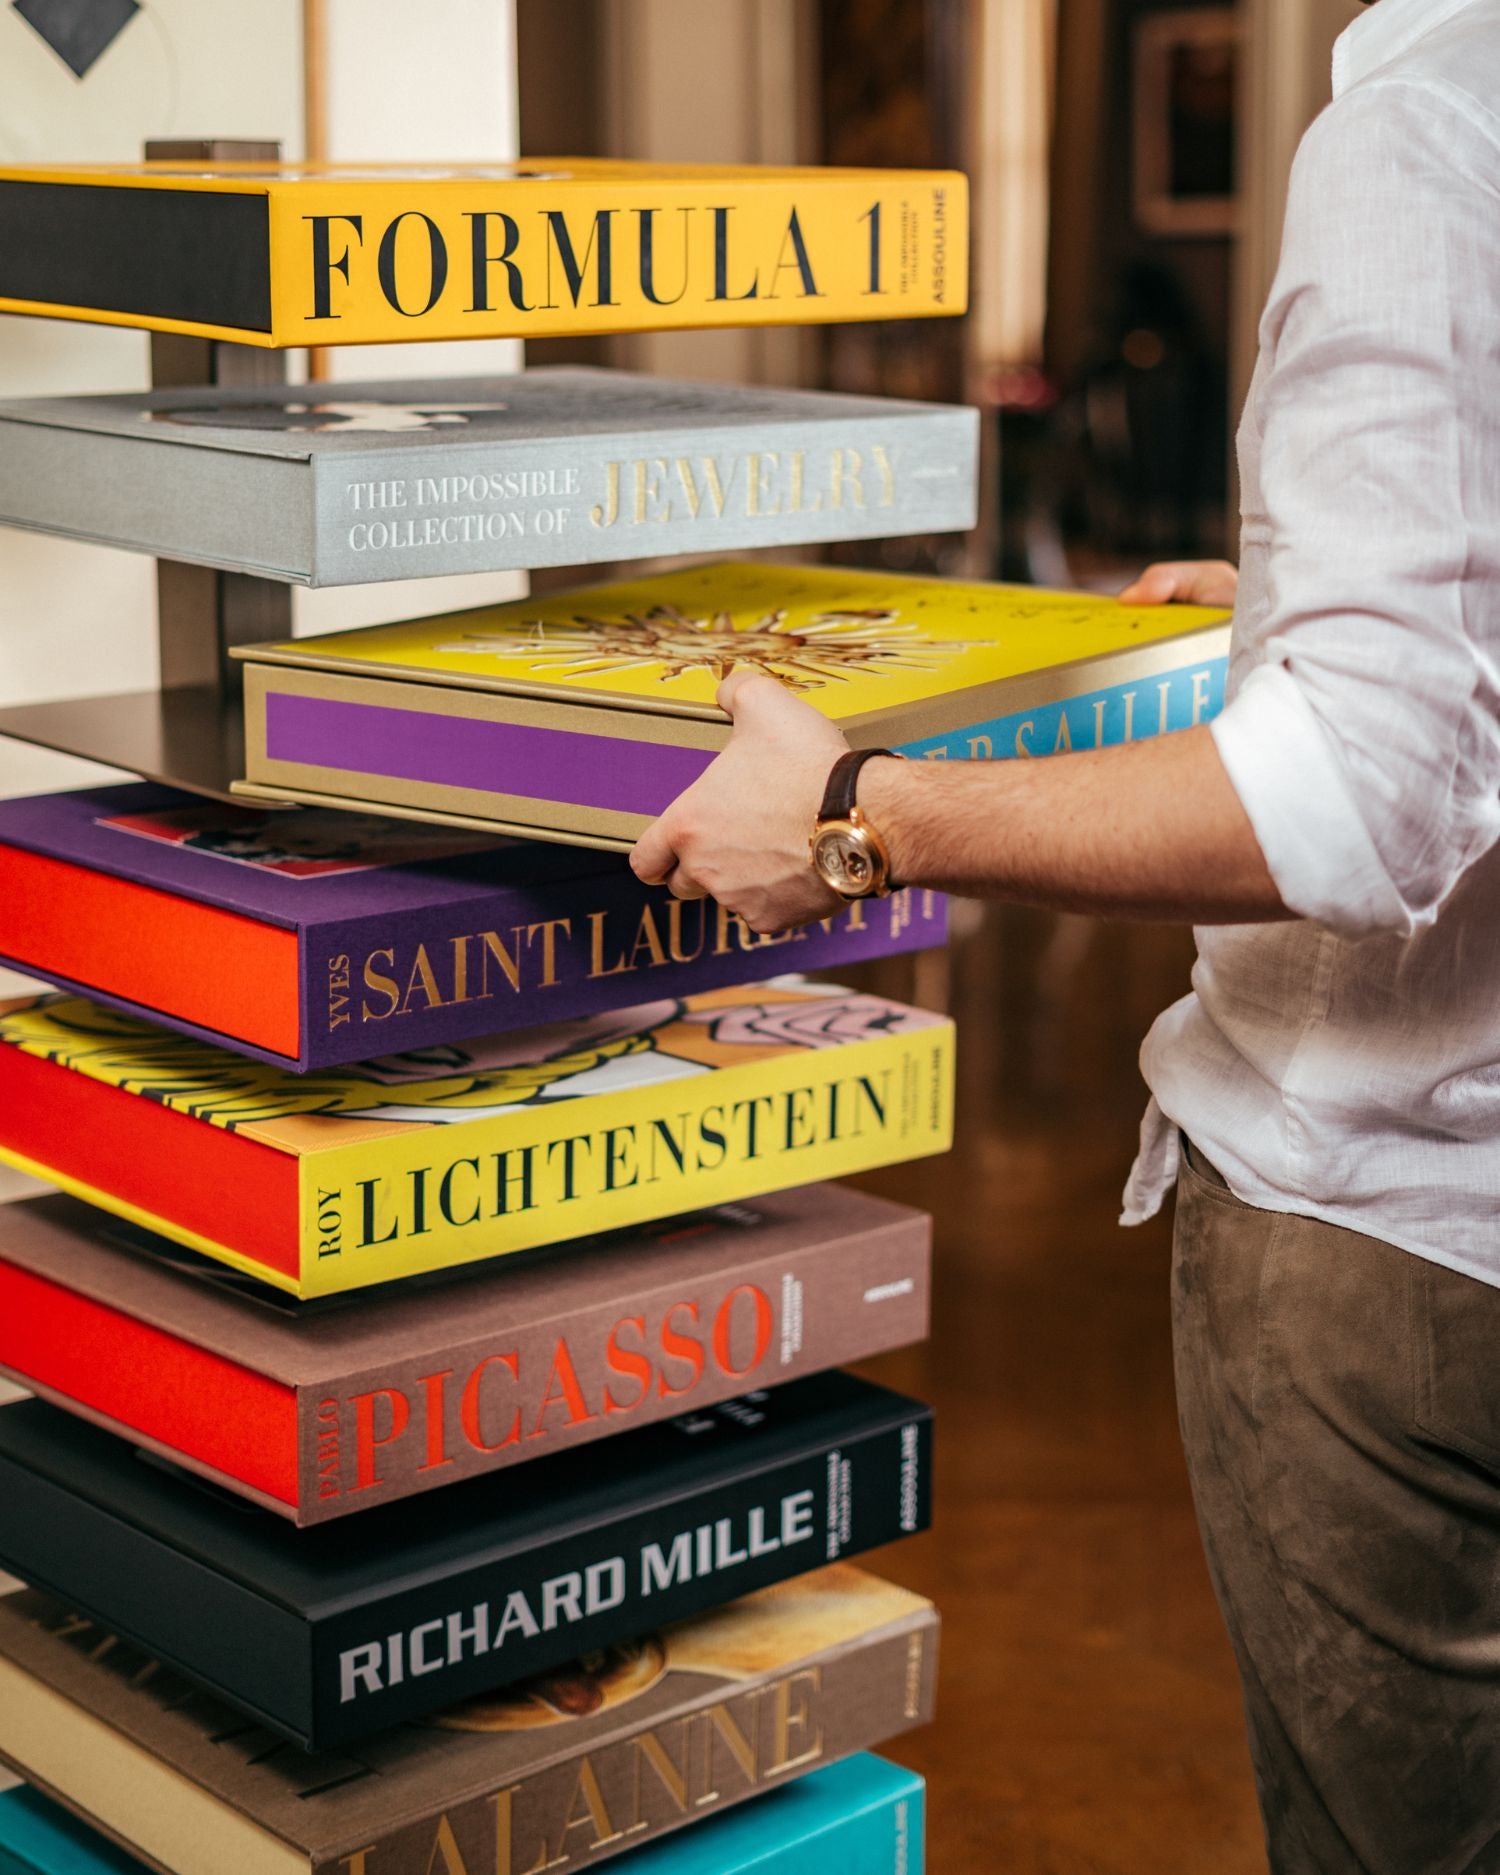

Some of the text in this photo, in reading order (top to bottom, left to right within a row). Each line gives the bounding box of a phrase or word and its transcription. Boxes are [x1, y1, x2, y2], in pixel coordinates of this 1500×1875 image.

[302, 201, 888, 321] FORMULA 1
[933, 188, 946, 305] ASSOULINE
[348, 468, 580, 510] THE IMPOSSIBLE
[348, 508, 571, 552] COLLECTION OF
[589, 444, 898, 528] JEWELRY
[329, 954, 350, 1032] YVES
[362, 918, 571, 1023] SAINT
[355, 1068, 893, 1249] LICHTENSTEIN
[318, 1187, 342, 1261] ROY
[347, 1284, 775, 1494] PICASSO
[318, 1398, 341, 1500] PABLO
[340, 1557, 627, 1703] RICHARD
[641, 1489, 815, 1596] MILLE
